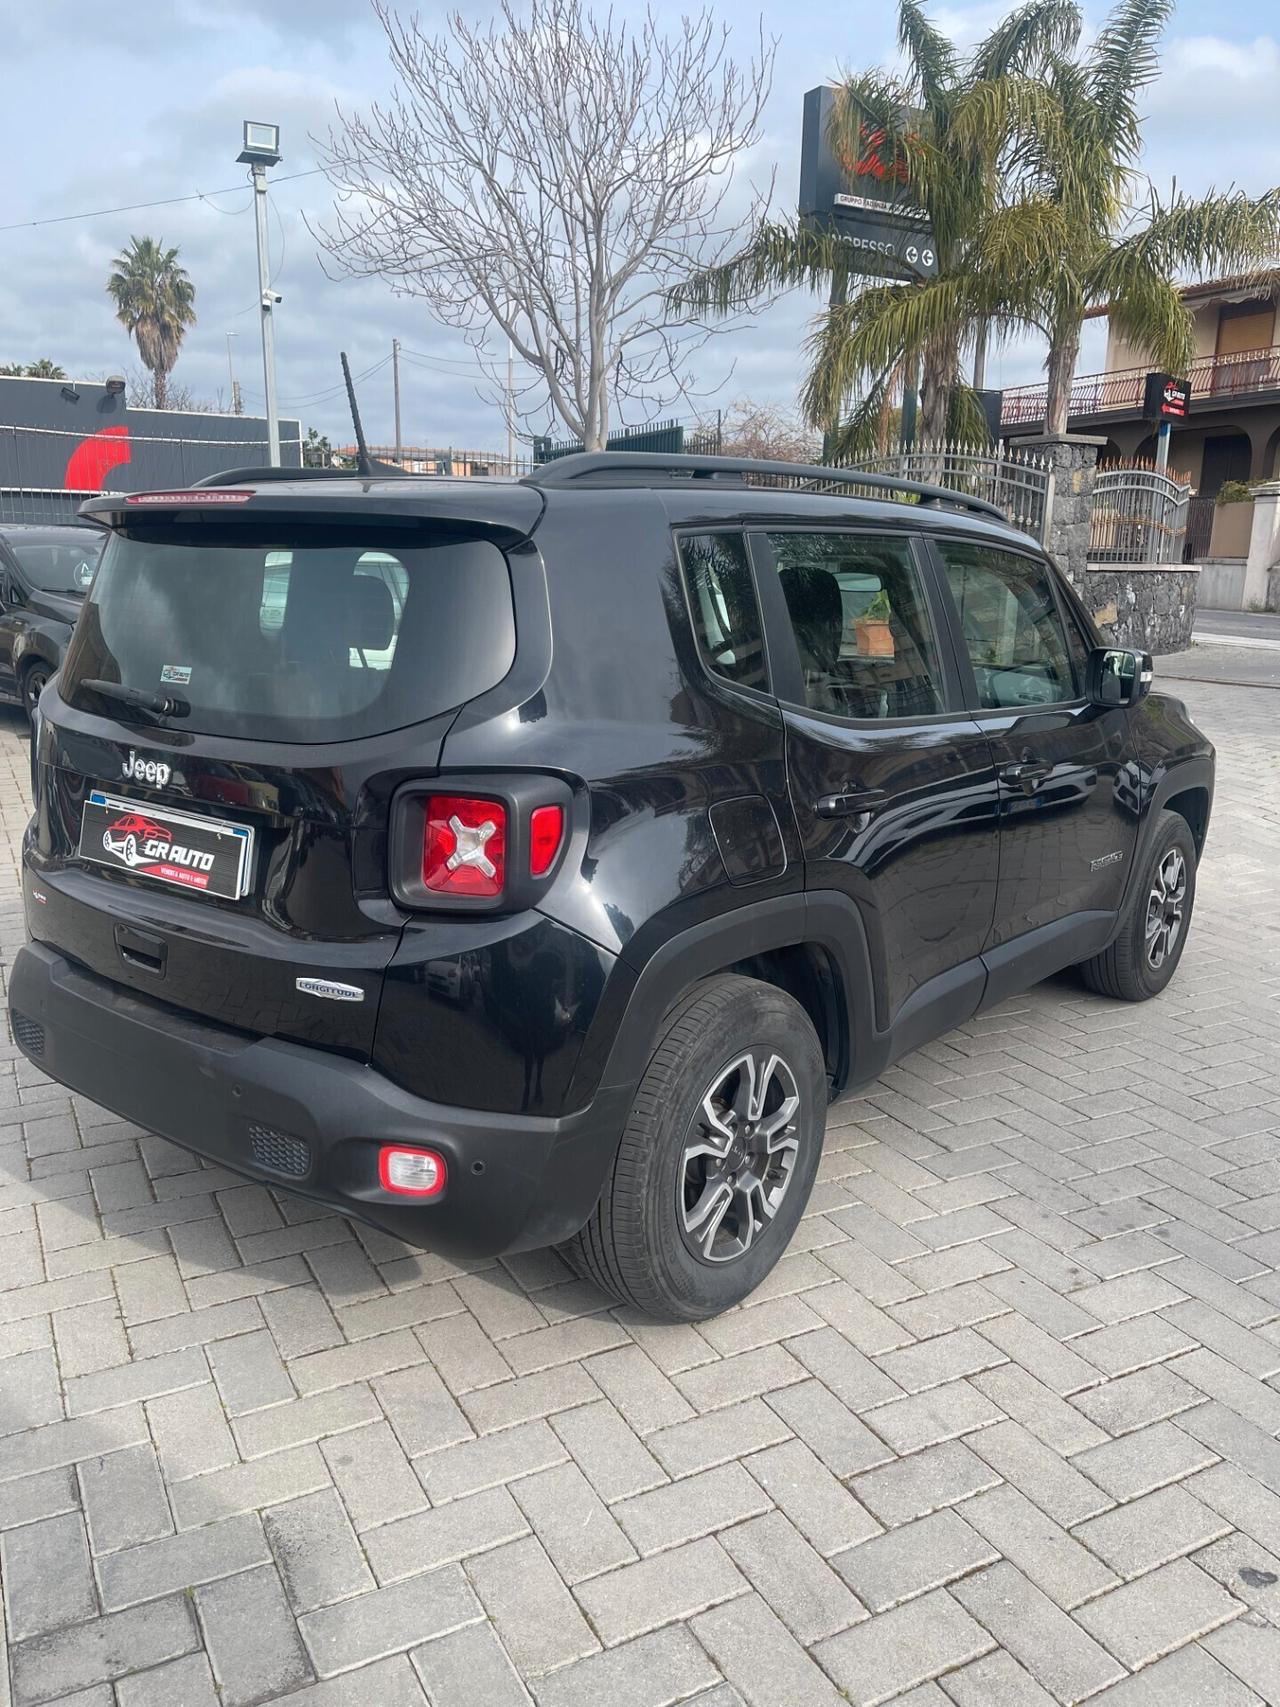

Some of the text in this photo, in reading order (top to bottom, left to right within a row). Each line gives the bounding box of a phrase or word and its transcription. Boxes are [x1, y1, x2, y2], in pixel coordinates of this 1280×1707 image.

[122, 750, 170, 788] Jeep
[144, 839, 215, 871] GR AUTO
[299, 981, 358, 998] LONGITUDE
